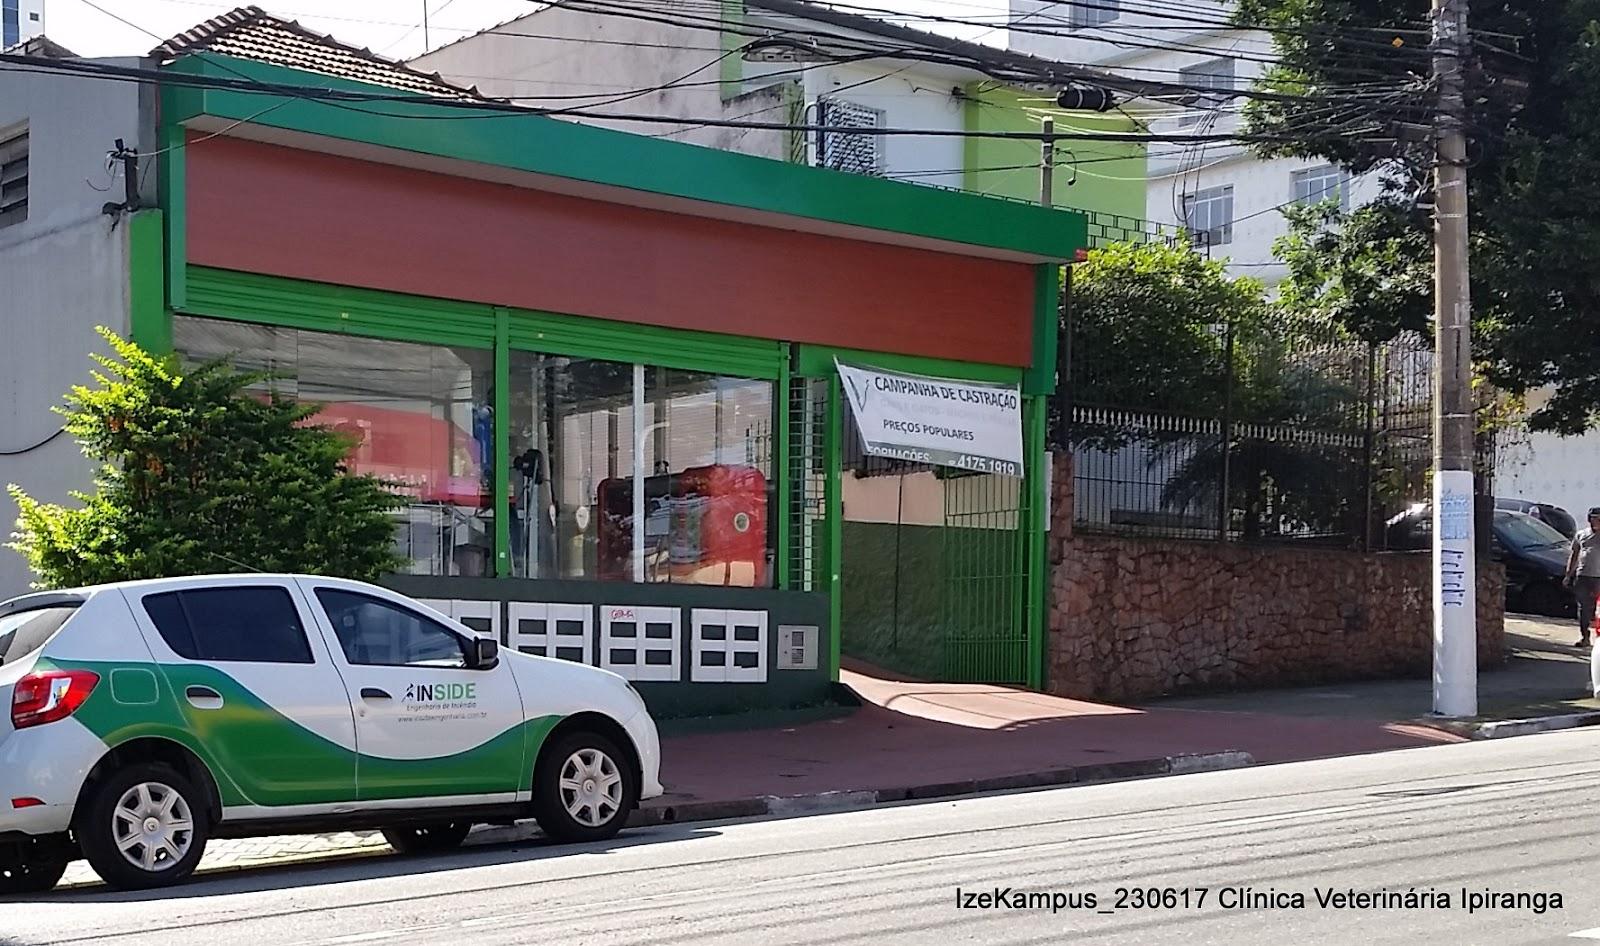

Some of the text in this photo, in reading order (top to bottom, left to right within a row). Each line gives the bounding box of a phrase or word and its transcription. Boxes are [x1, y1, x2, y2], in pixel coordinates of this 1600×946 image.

[875, 376, 1017, 411] CAMPANHA DE CASTRAÇÃO
[883, 418, 975, 441] PREÇOS POPULARES
[989, 459, 1015, 476] 1919
[416, 683, 476, 701] INSIDE
